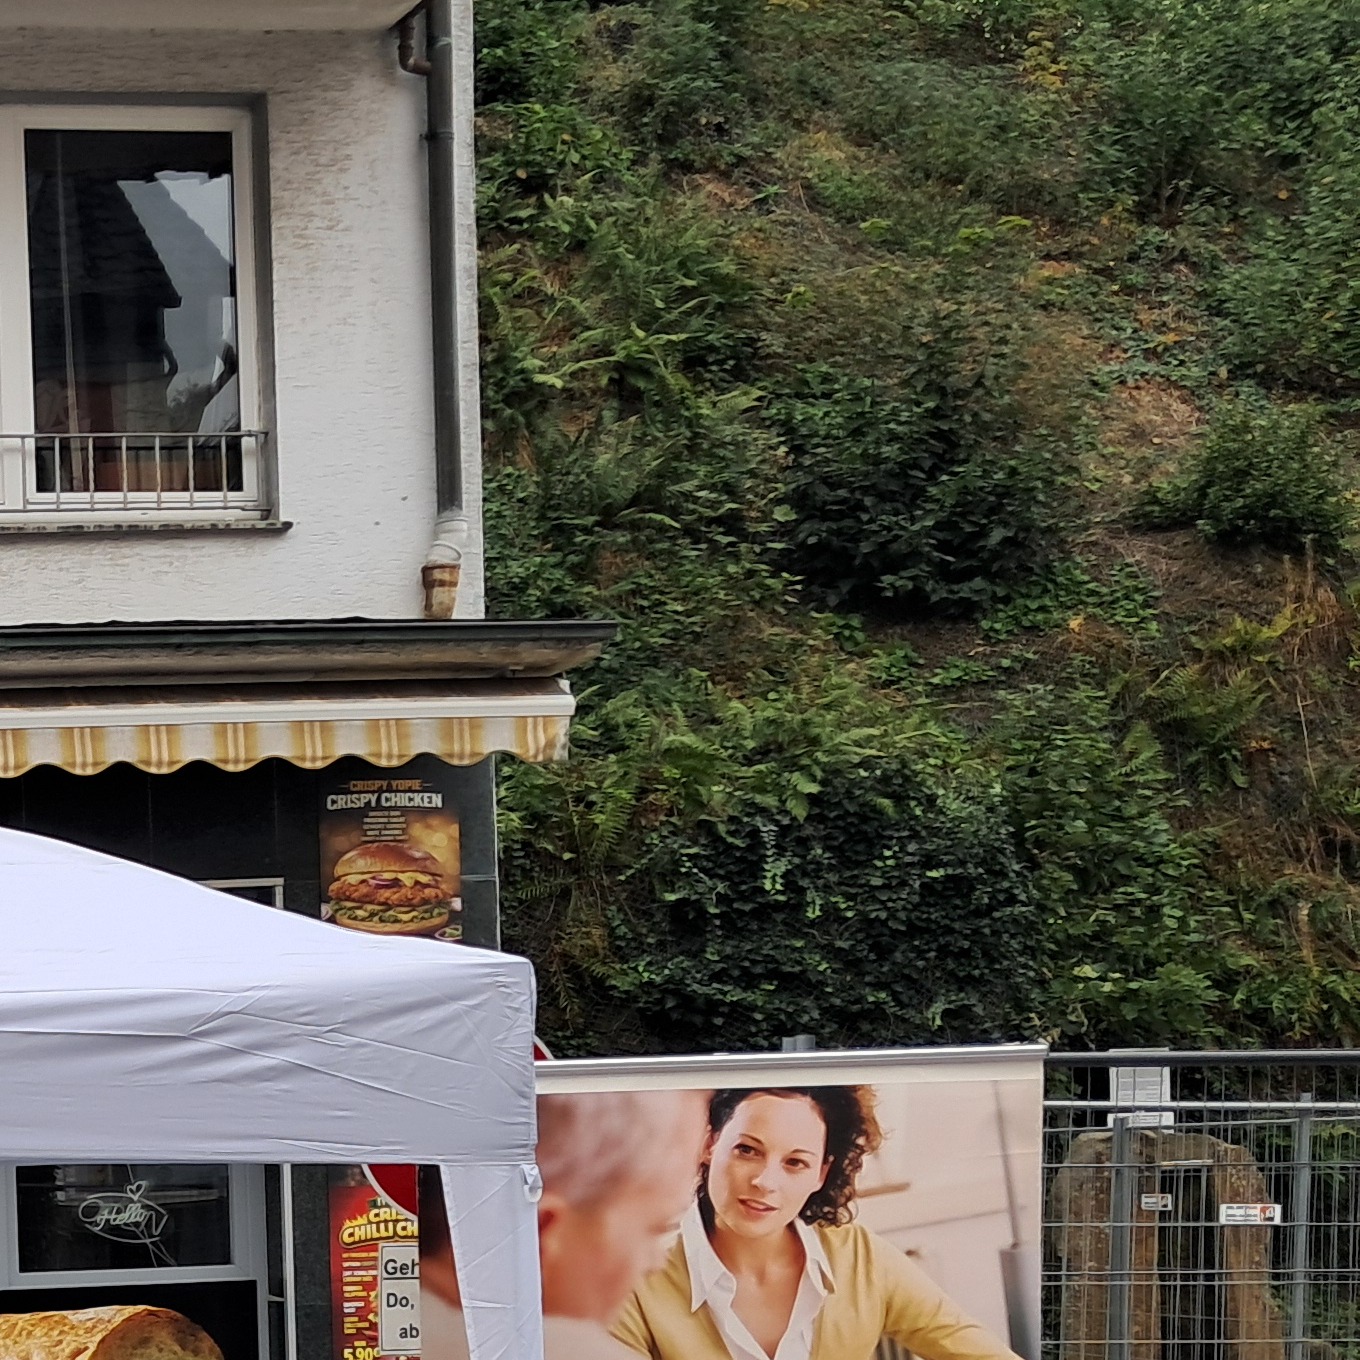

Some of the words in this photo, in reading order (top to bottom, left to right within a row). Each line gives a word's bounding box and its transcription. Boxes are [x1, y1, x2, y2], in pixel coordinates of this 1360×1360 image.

[327, 793, 379, 810] CRISPY
[381, 793, 442, 808] CHICKEN
[342, 1222, 394, 1243] CHILLI
